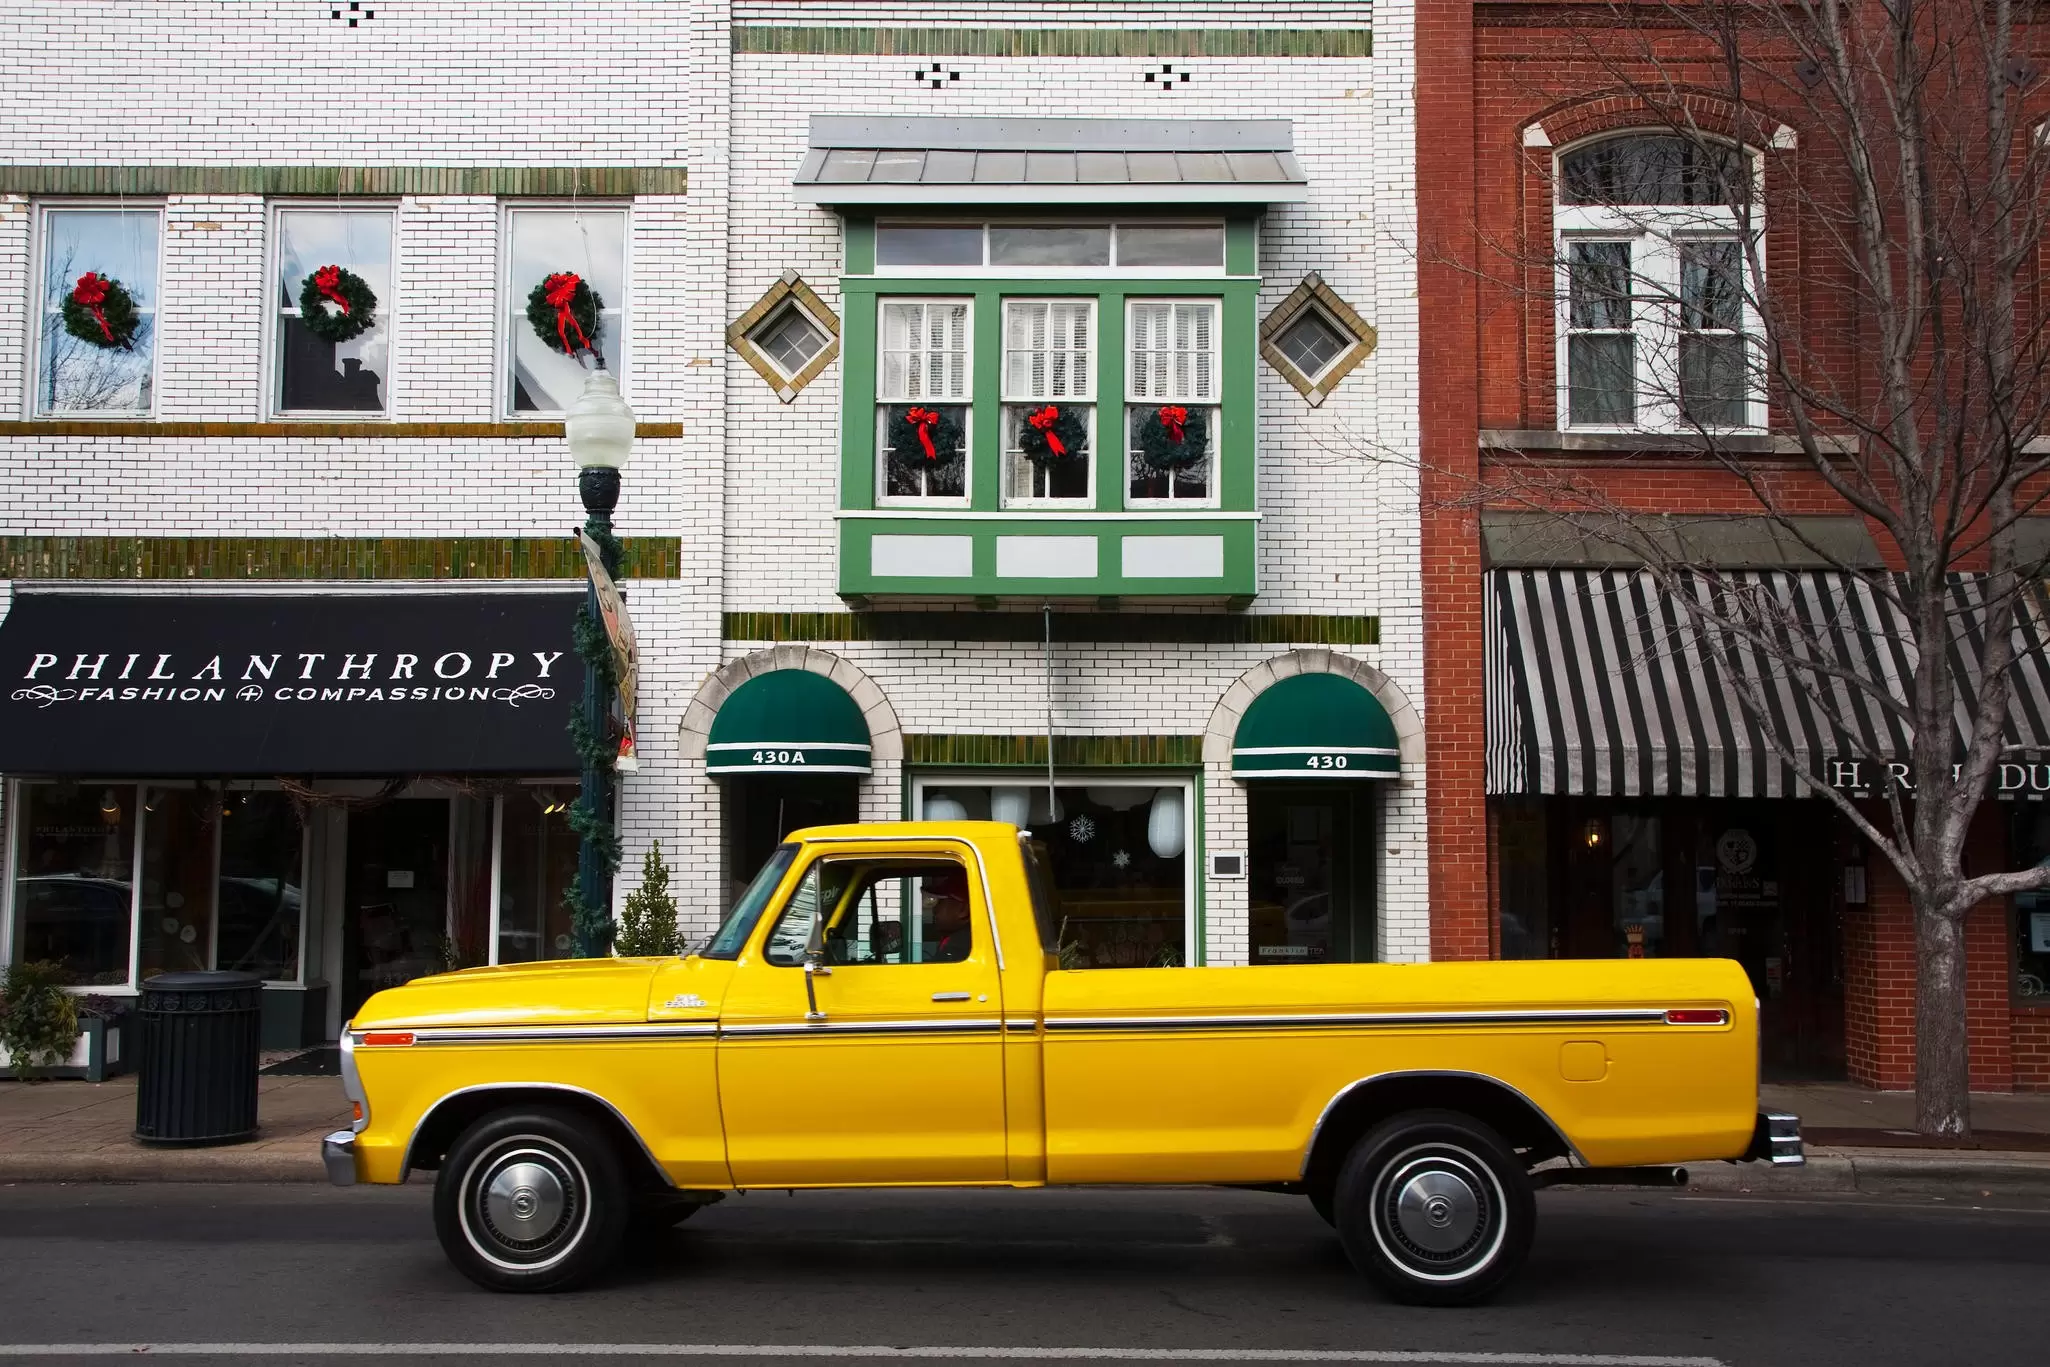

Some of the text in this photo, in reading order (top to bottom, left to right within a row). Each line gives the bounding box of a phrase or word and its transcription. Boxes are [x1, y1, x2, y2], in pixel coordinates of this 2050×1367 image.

[24, 651, 563, 680] PHILANTHROPY
[78, 686, 225, 702] FASHION
[274, 686, 490, 702] COMPASSION
[752, 750, 806, 764] 430A
[1306, 755, 1347, 769] 430
[1832, 761, 1870, 788] H.
[1998, 763, 2050, 791] DU
